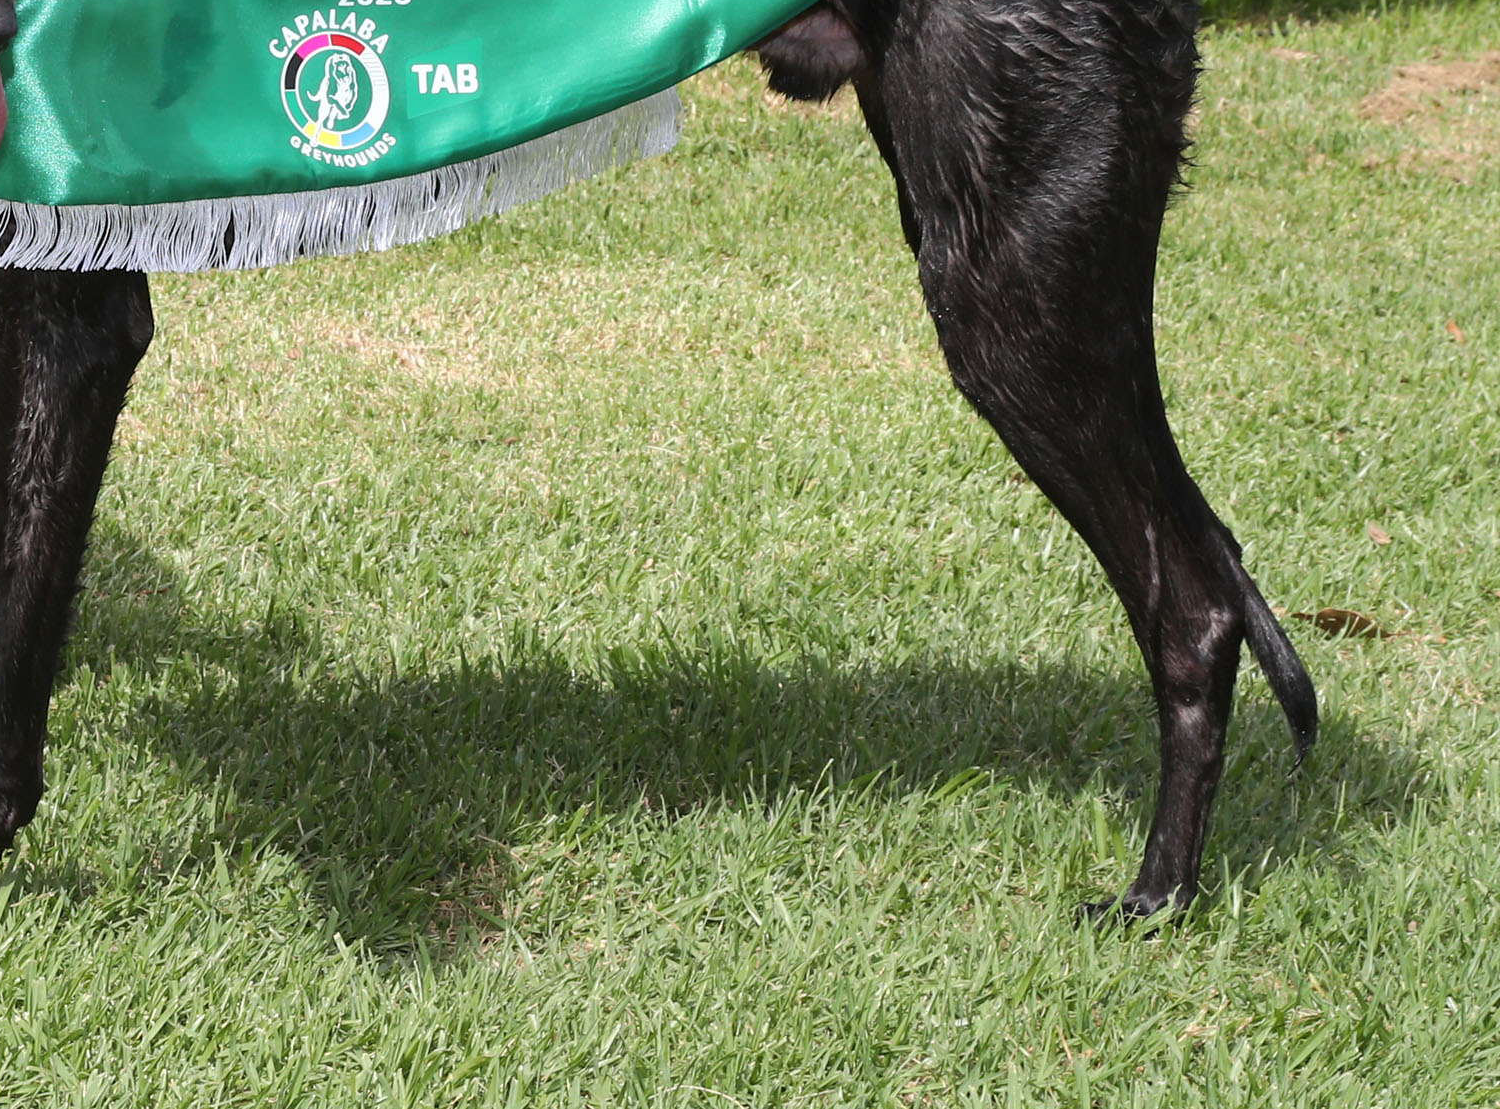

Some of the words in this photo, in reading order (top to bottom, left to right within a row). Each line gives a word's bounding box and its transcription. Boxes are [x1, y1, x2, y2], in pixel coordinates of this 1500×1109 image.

[268, 7, 390, 59] CAPALABA
[411, 62, 479, 95] TAB
[289, 131, 397, 169] GREYHOUNDS
